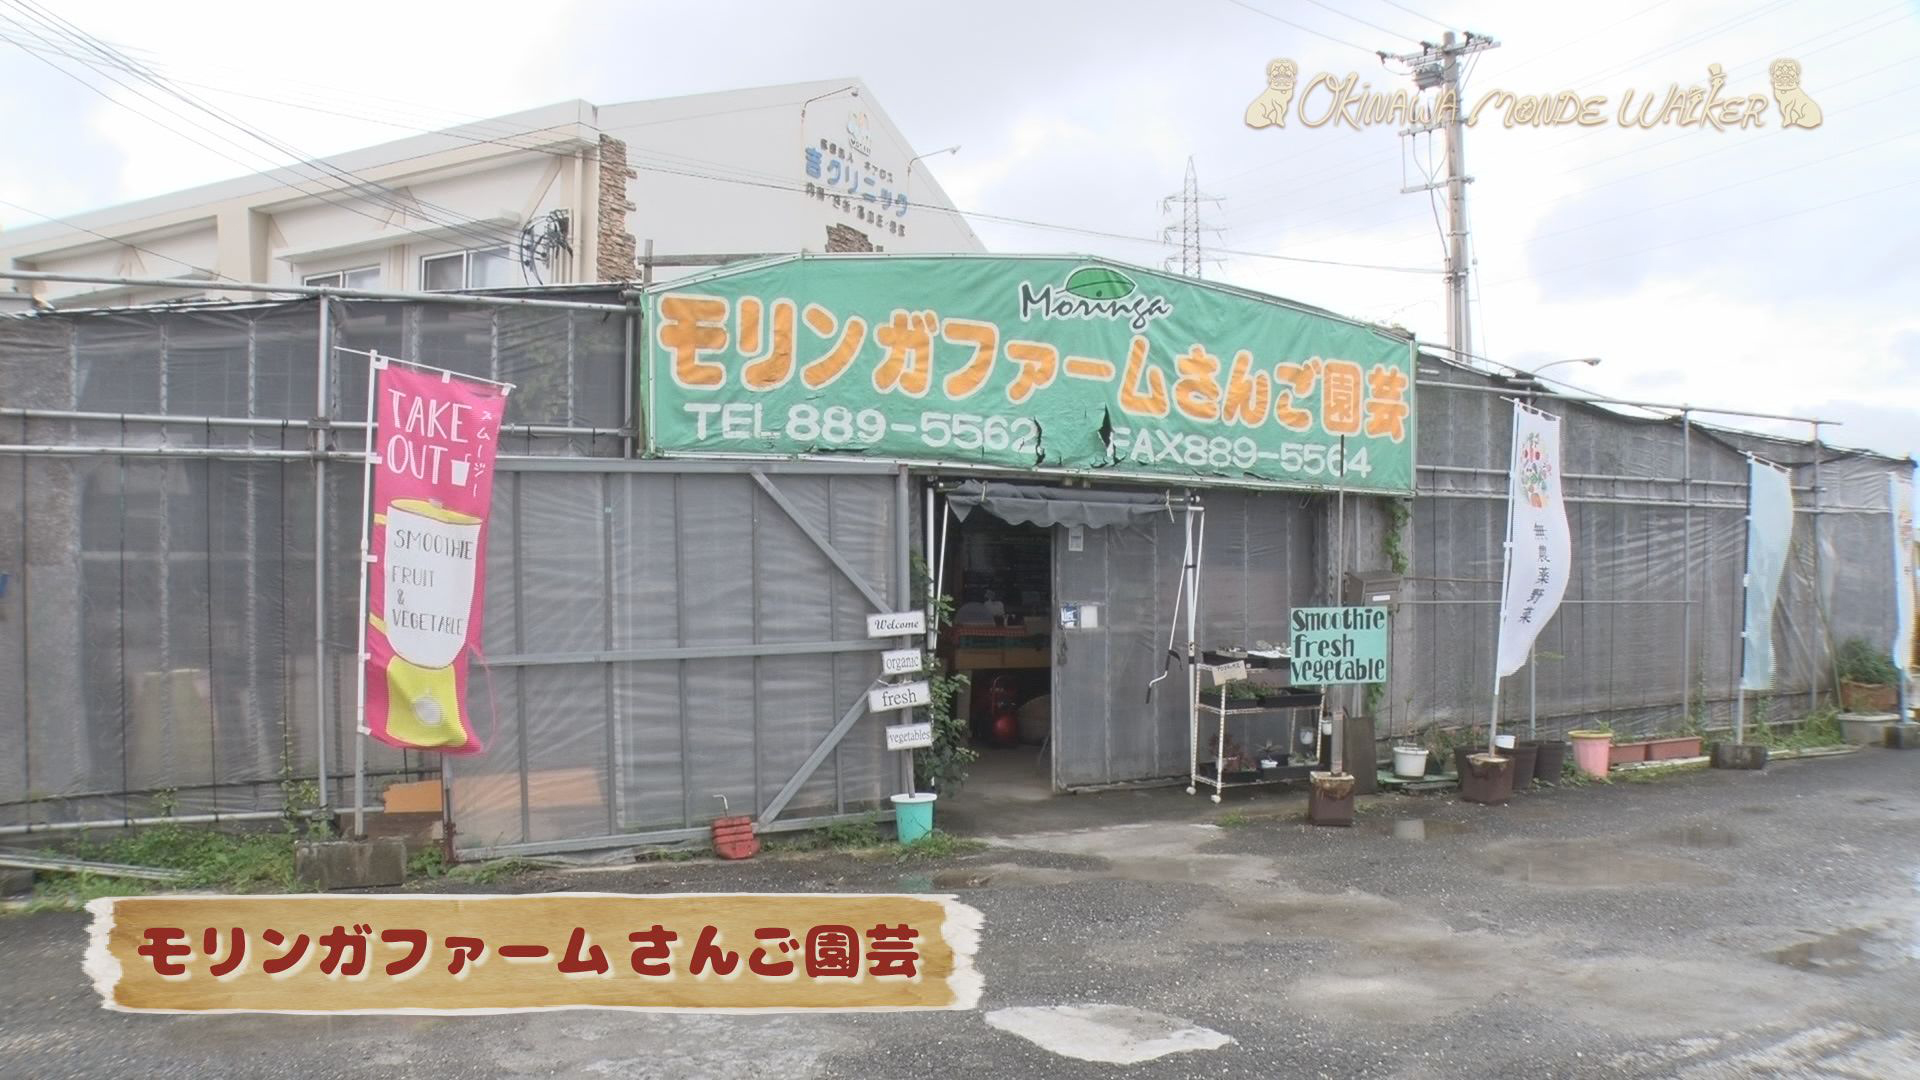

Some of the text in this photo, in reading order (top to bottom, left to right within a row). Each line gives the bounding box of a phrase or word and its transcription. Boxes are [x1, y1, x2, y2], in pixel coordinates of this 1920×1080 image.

[1020, 282, 1172, 331] Moringa
[387, 388, 473, 443] TAKE
[387, 434, 449, 485] OUT
[473, 410, 492, 497] スムージー
[394, 529, 473, 560] SMOOTHIE
[391, 565, 434, 588] FRUIT
[396, 588, 405, 606] &
[392, 608, 464, 636] VEGETABLE
[874, 618, 919, 631] Welcome
[1292, 607, 1385, 632] Smoothie
[1293, 633, 1355, 659] fresh
[886, 654, 919, 671] organic
[1291, 658, 1385, 682] vegetable
[882, 688, 918, 707] fresh
[889, 728, 931, 745] vegetables
